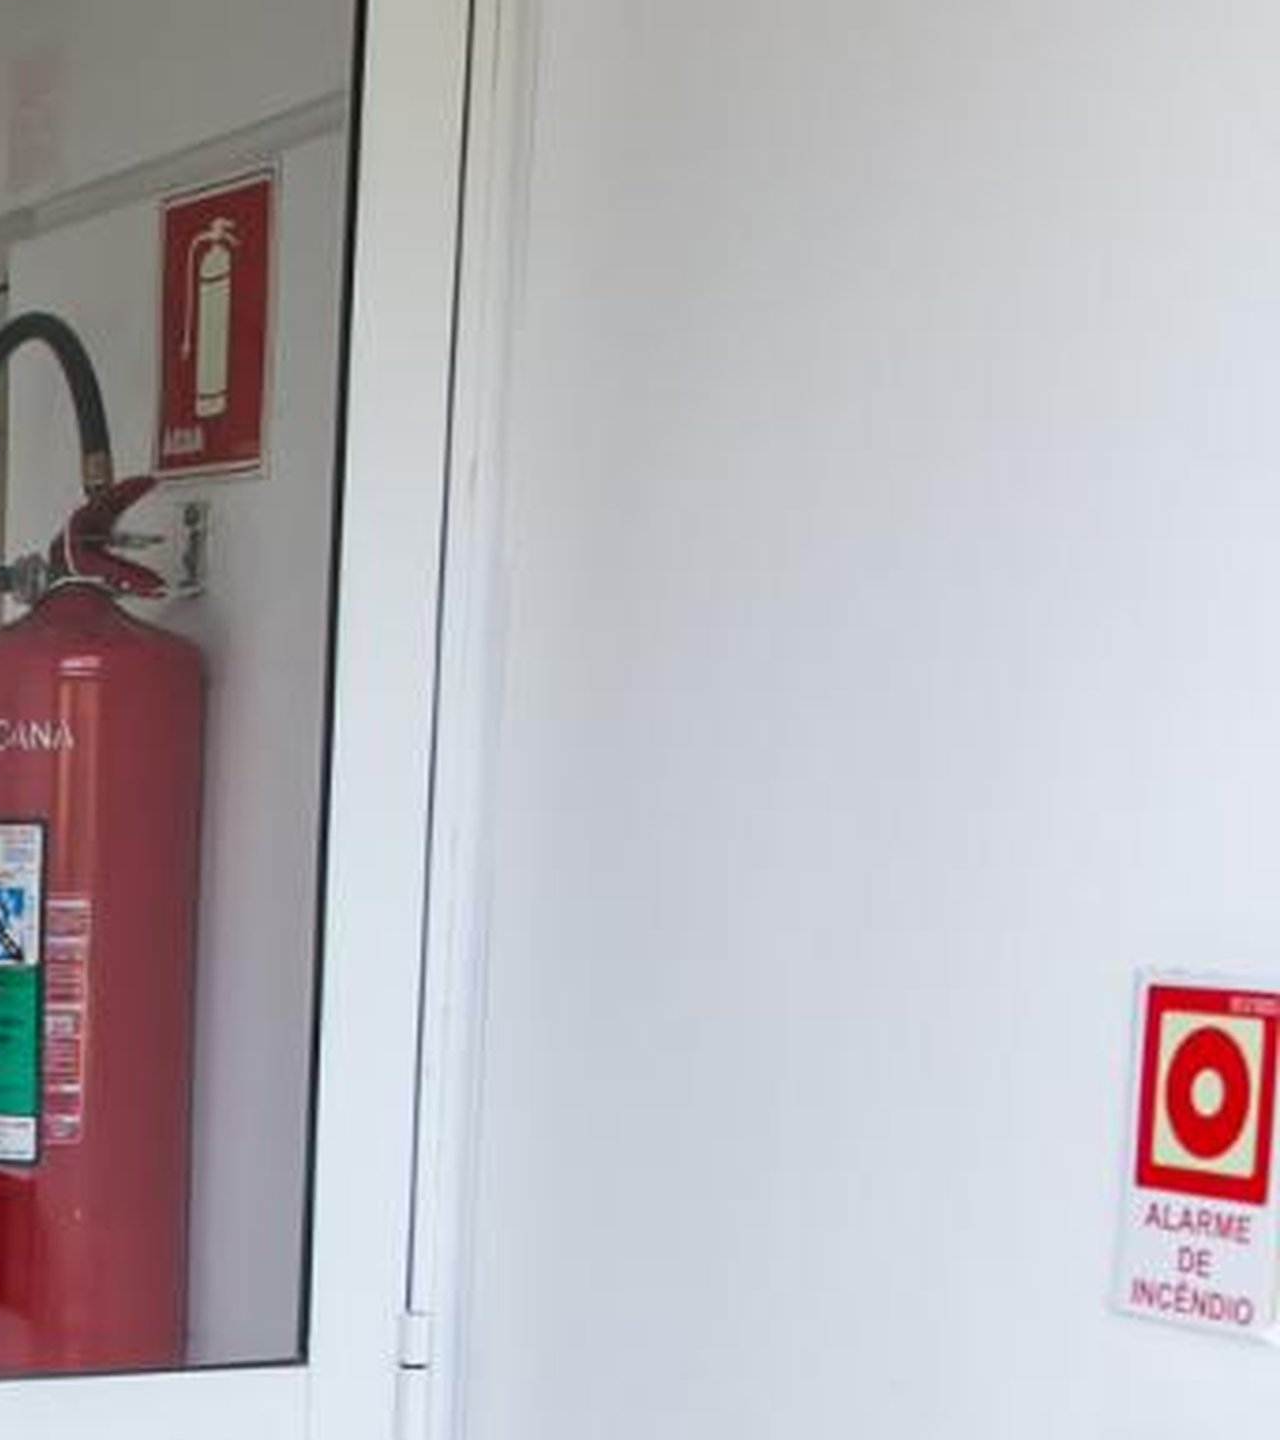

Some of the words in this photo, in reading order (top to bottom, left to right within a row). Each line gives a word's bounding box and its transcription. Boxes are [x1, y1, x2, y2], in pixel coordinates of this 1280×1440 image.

[1144, 1201, 1251, 1245] ALARME
[1177, 1245, 1213, 1278] DE
[1130, 1277, 1255, 1326] INCÊNDIO
